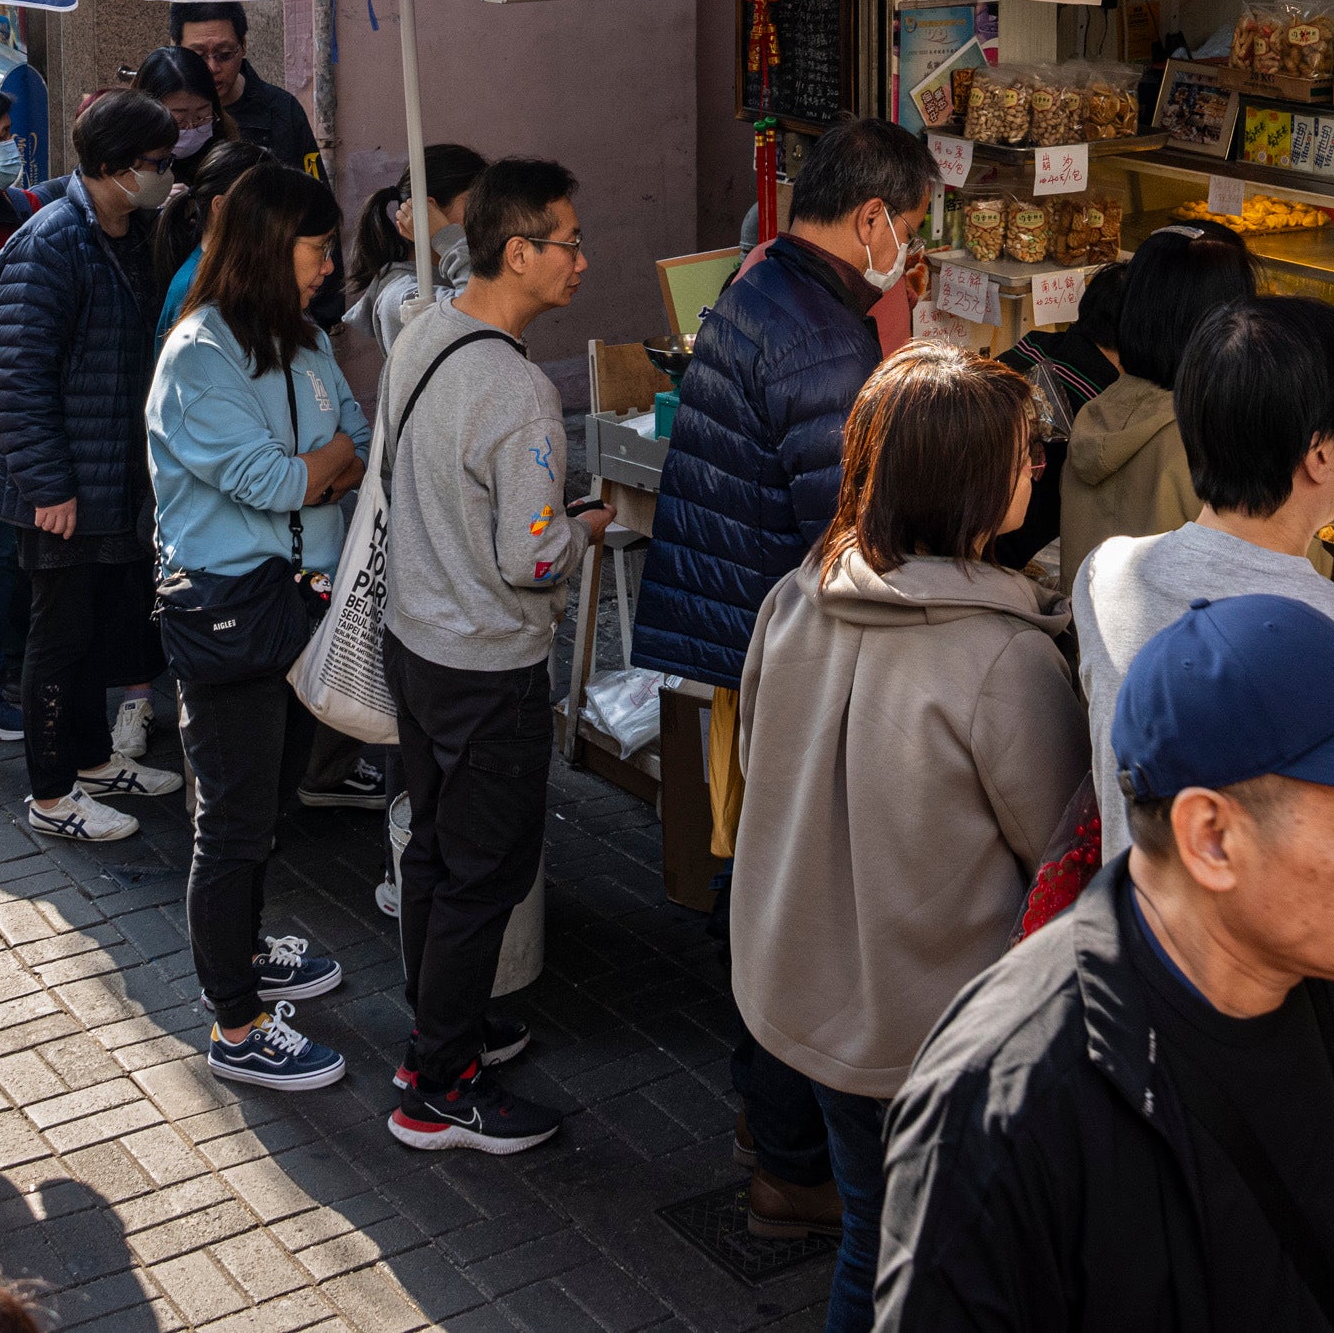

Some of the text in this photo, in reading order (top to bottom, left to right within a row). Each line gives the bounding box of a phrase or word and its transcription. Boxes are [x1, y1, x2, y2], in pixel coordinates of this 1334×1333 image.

[213, 620, 233, 631] AIGLE
[337, 618, 360, 636] TAIPEI
[340, 608, 368, 629] SEOUL
